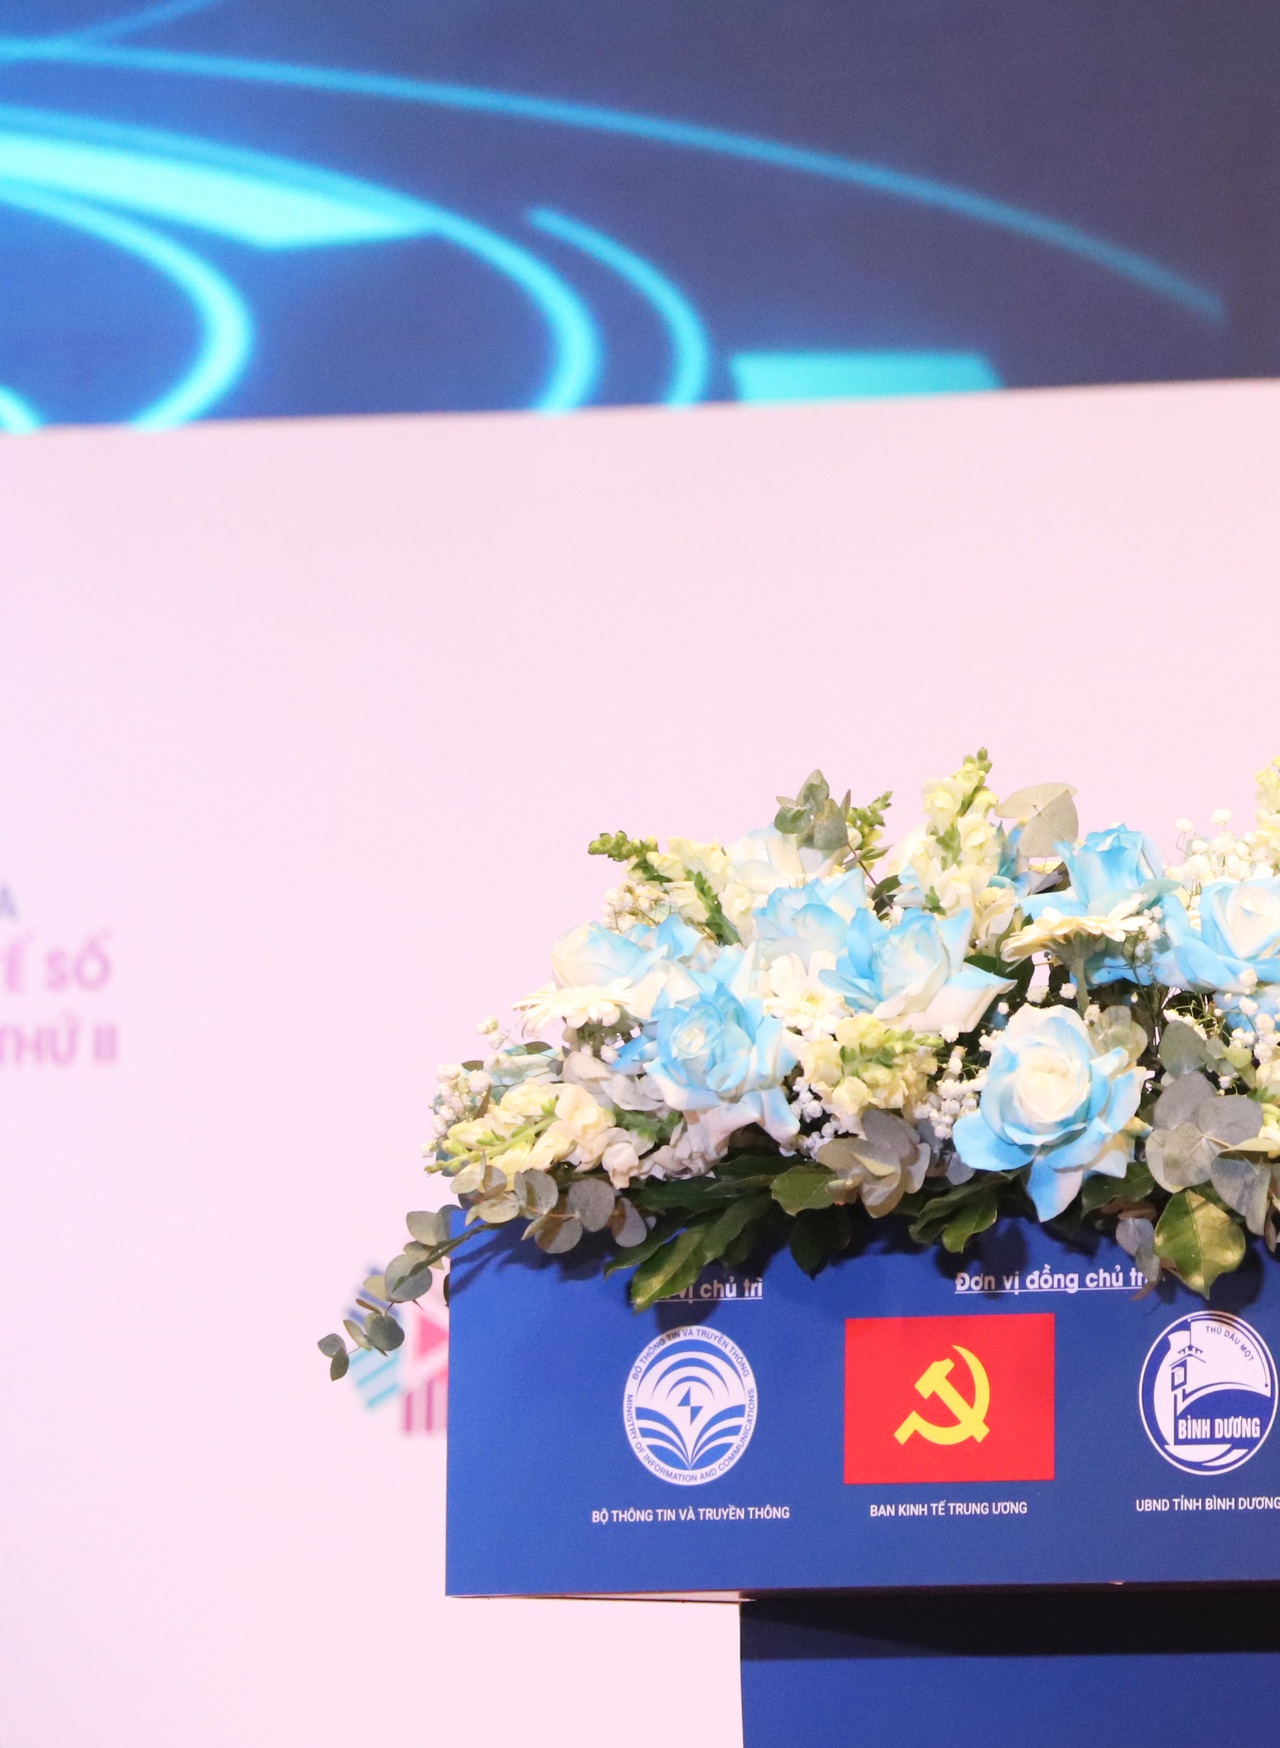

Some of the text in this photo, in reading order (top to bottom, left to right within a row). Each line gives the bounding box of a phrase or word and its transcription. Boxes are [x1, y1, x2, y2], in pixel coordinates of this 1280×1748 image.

[700, 1276, 738, 1298] chủ
[743, 1276, 763, 1298] trì
[955, 1272, 996, 1291] Đơn
[1003, 1271, 1020, 1295] vị
[1026, 1263, 1080, 1294] đồng
[1085, 1264, 1124, 1288] chủ
[666, 1330, 681, 1342] TIN
[626, 1388, 756, 1483] MINISTRY OF INFORMATION AND COMMUNICATIONS
[1178, 1415, 1261, 1439] BÌNH DƯƠNG
[870, 1500, 1028, 1517] BAN KINH TẾ TRUNG ƯƠNG
[1136, 1499, 1170, 1511] UBND
[1173, 1495, 1202, 1511] TỈNH
[1205, 1495, 1235, 1510] BÌNH
[592, 1504, 790, 1525] BỘ THÔNG TIN VÀ TRUYỀN THÔNG
